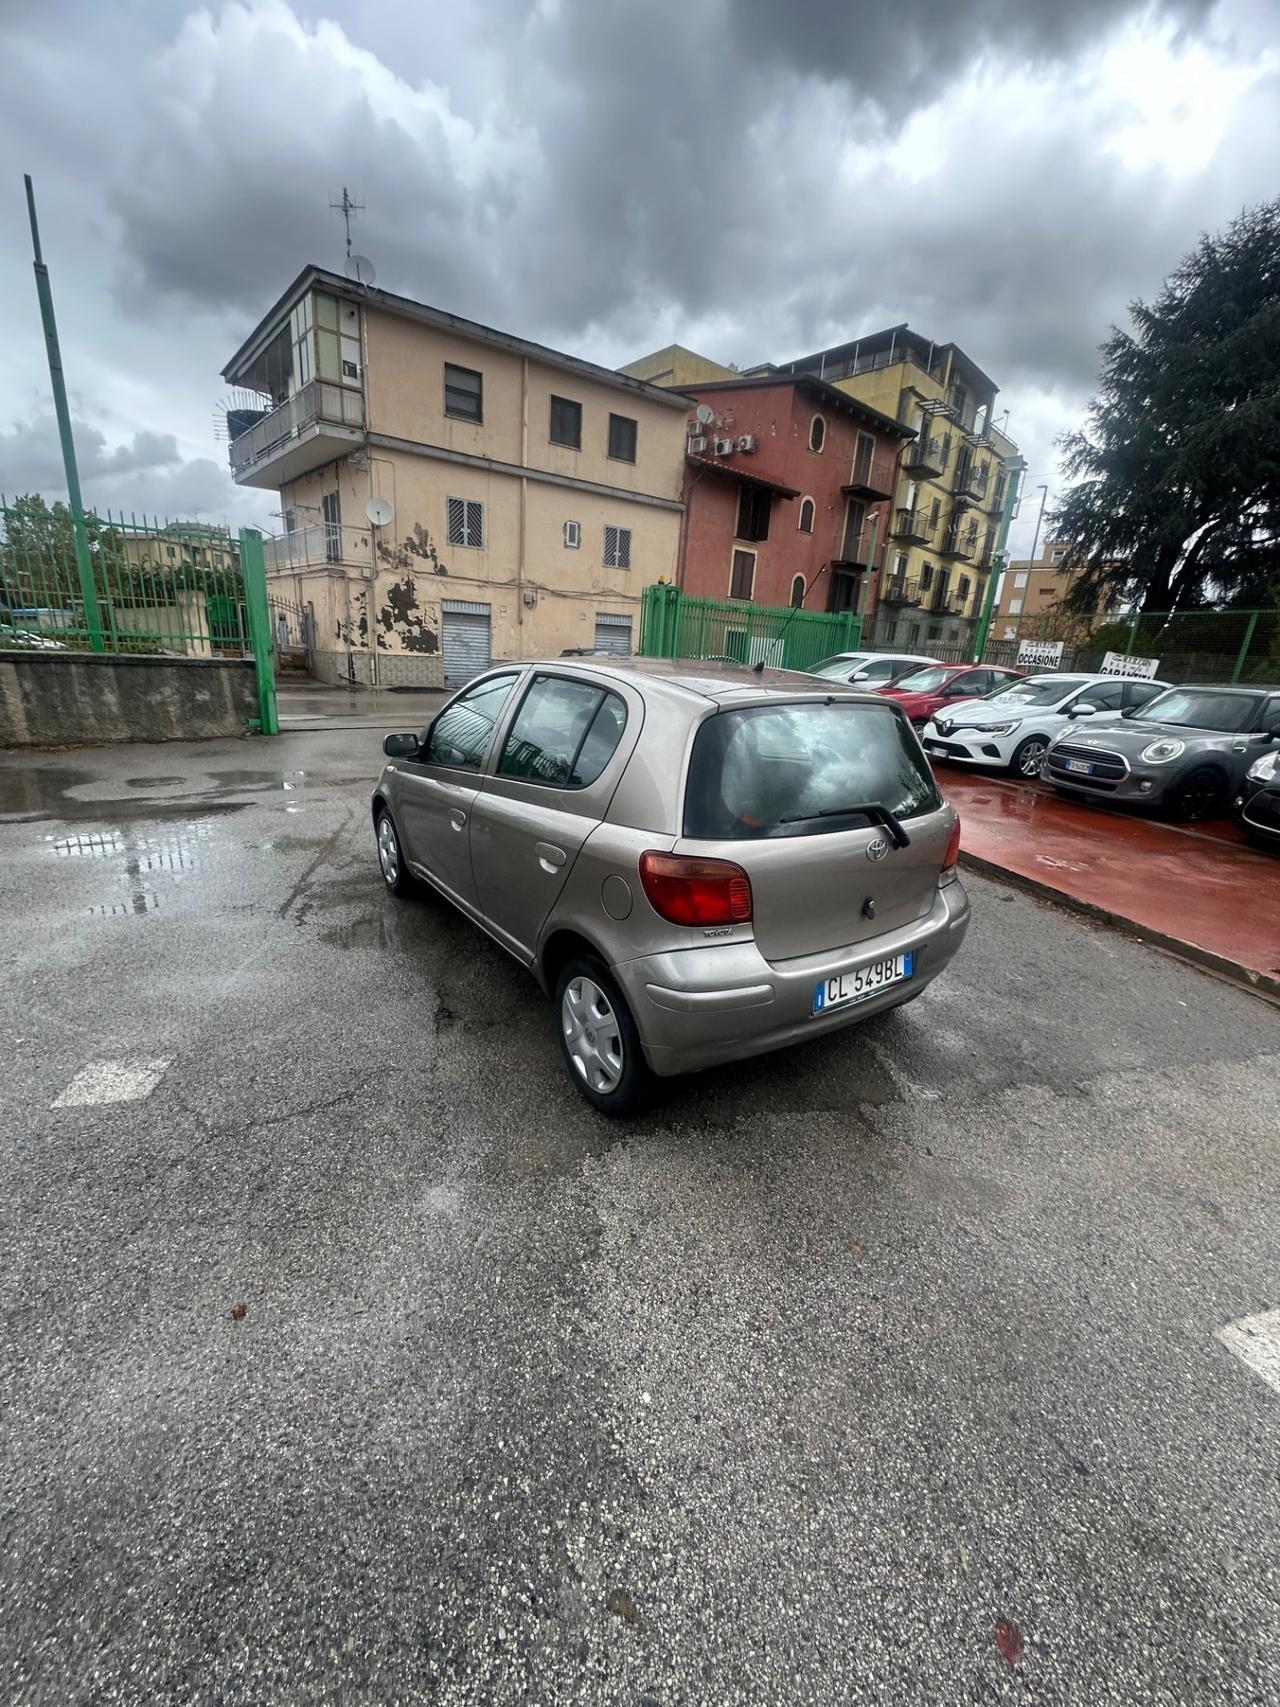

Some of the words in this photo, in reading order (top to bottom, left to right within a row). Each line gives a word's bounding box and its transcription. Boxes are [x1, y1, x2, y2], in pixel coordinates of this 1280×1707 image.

[1018, 653, 1059, 667] OCCASIONE
[703, 928, 736, 938] TOYOTA
[828, 976, 848, 1002] CL
[854, 956, 902, 992] 549BL
